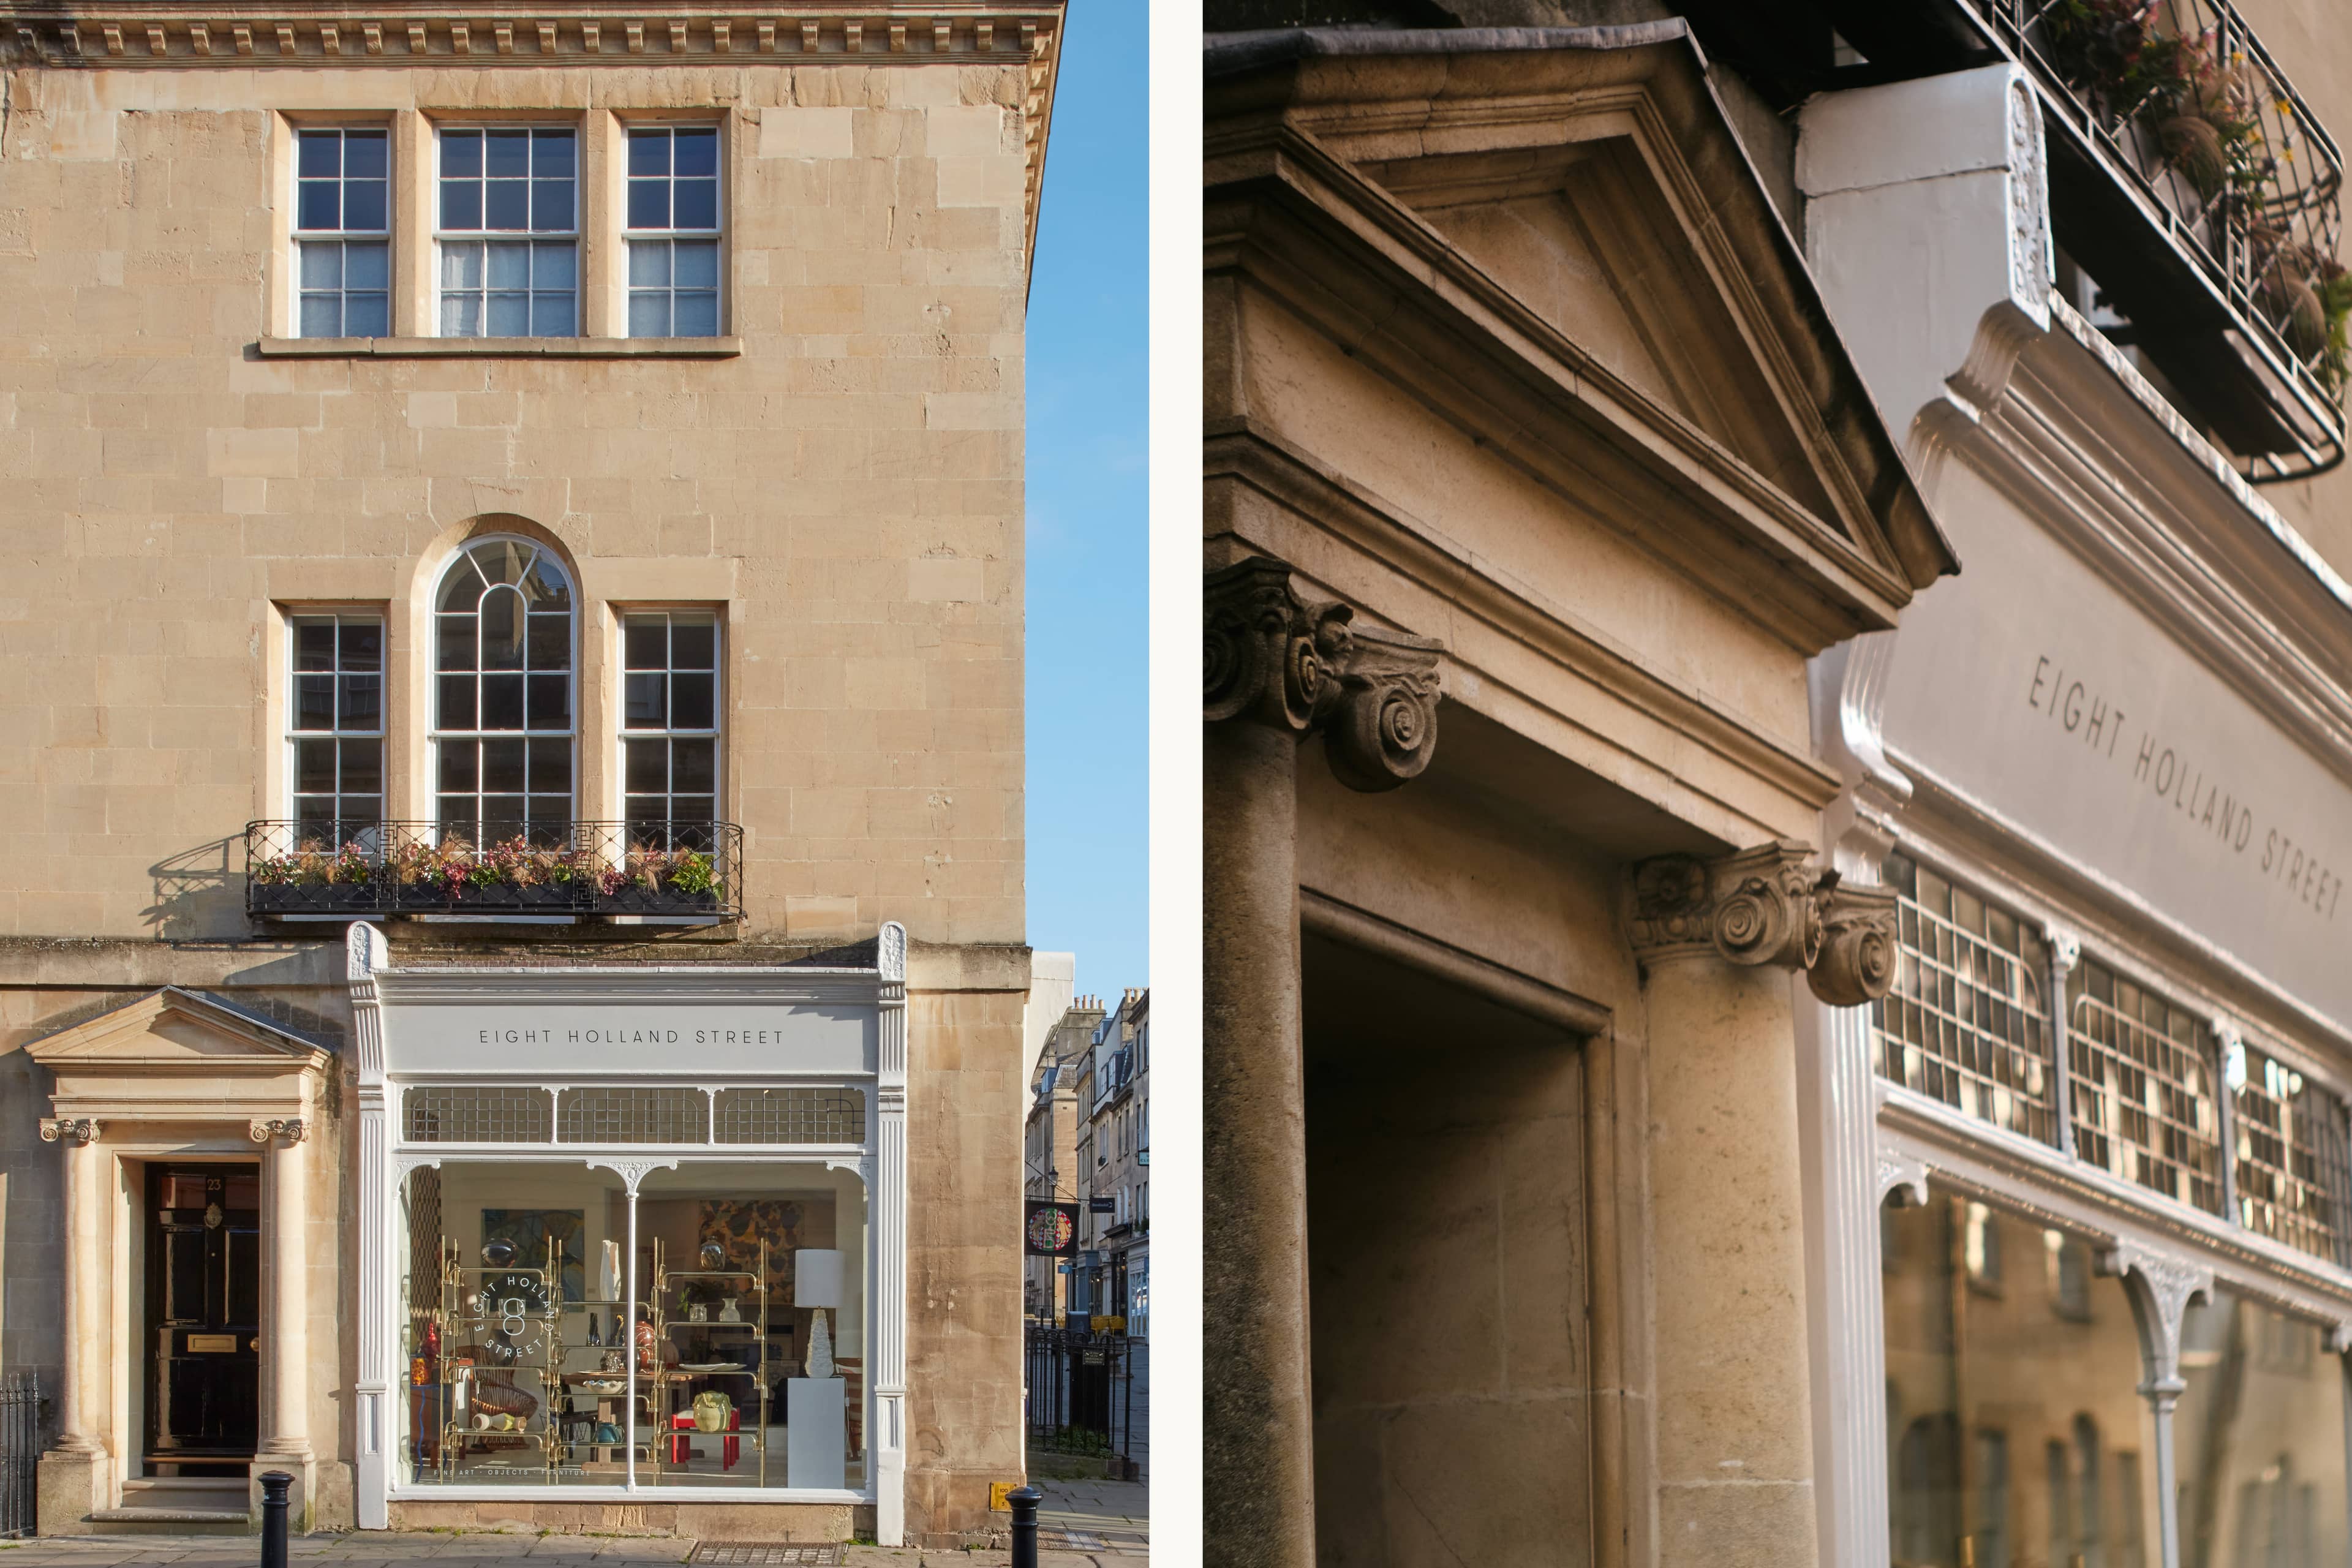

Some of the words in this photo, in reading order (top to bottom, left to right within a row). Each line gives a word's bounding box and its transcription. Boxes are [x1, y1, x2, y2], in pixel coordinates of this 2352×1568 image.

[2029, 655, 2125, 759] EIGHT
[2134, 732, 2253, 853] HOLLAND
[2261, 827, 2343, 921] STREET
[480, 1030, 551, 1043] EIGHT
[569, 1030, 679, 1043] HOLLAND
[695, 1030, 783, 1044] STREET
[207, 1178, 221, 1191] 23
[473, 1283, 496, 1332] EIGHT
[507, 1276, 554, 1332] HOLLAND
[503, 1298, 525, 1336] 8
[485, 1338, 542, 1358] STREET
